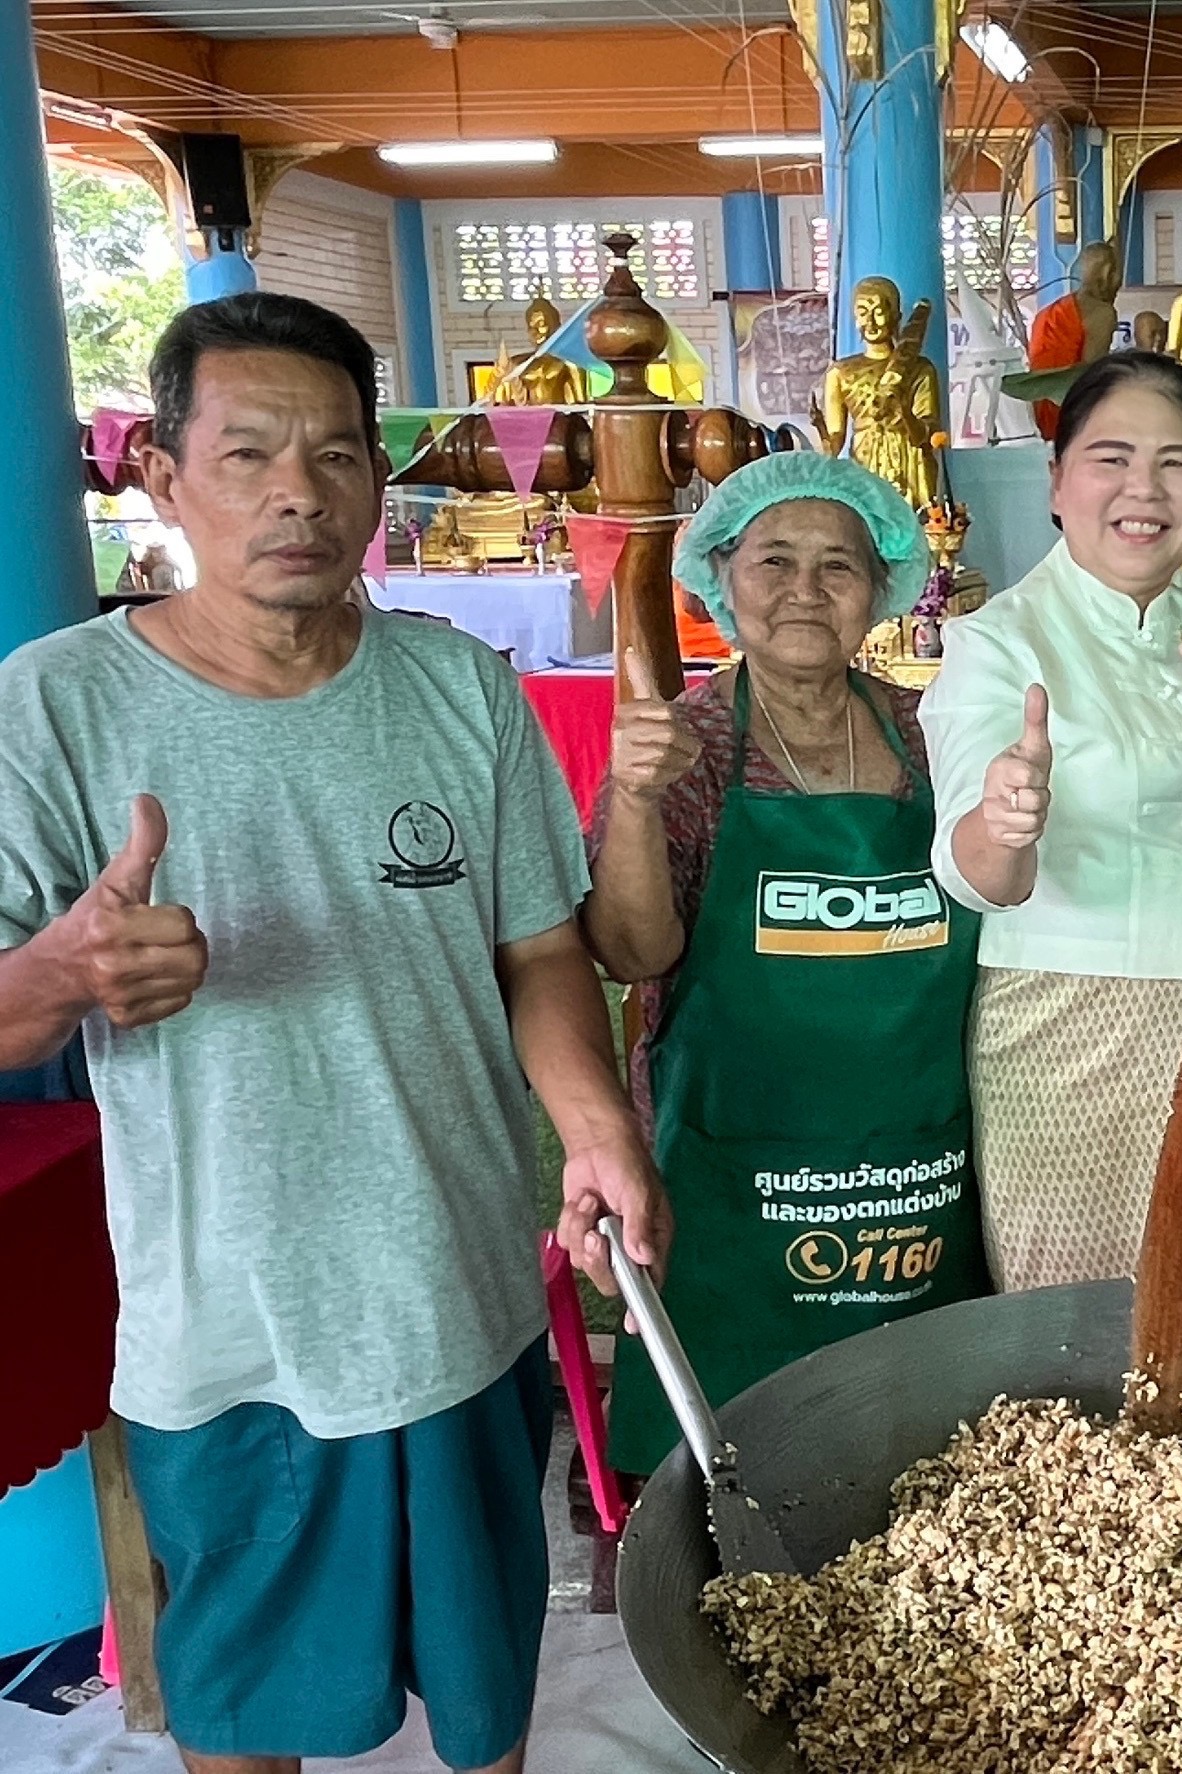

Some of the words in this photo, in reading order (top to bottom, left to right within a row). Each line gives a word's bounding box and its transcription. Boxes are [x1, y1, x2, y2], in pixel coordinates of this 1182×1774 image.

[755, 1150, 965, 1197] ศูนย์รวมวัสดุก่อสร้าง
[762, 1181, 961, 1223] และของตกแต่งบ้าน
[851, 1237, 943, 1281] 1160
